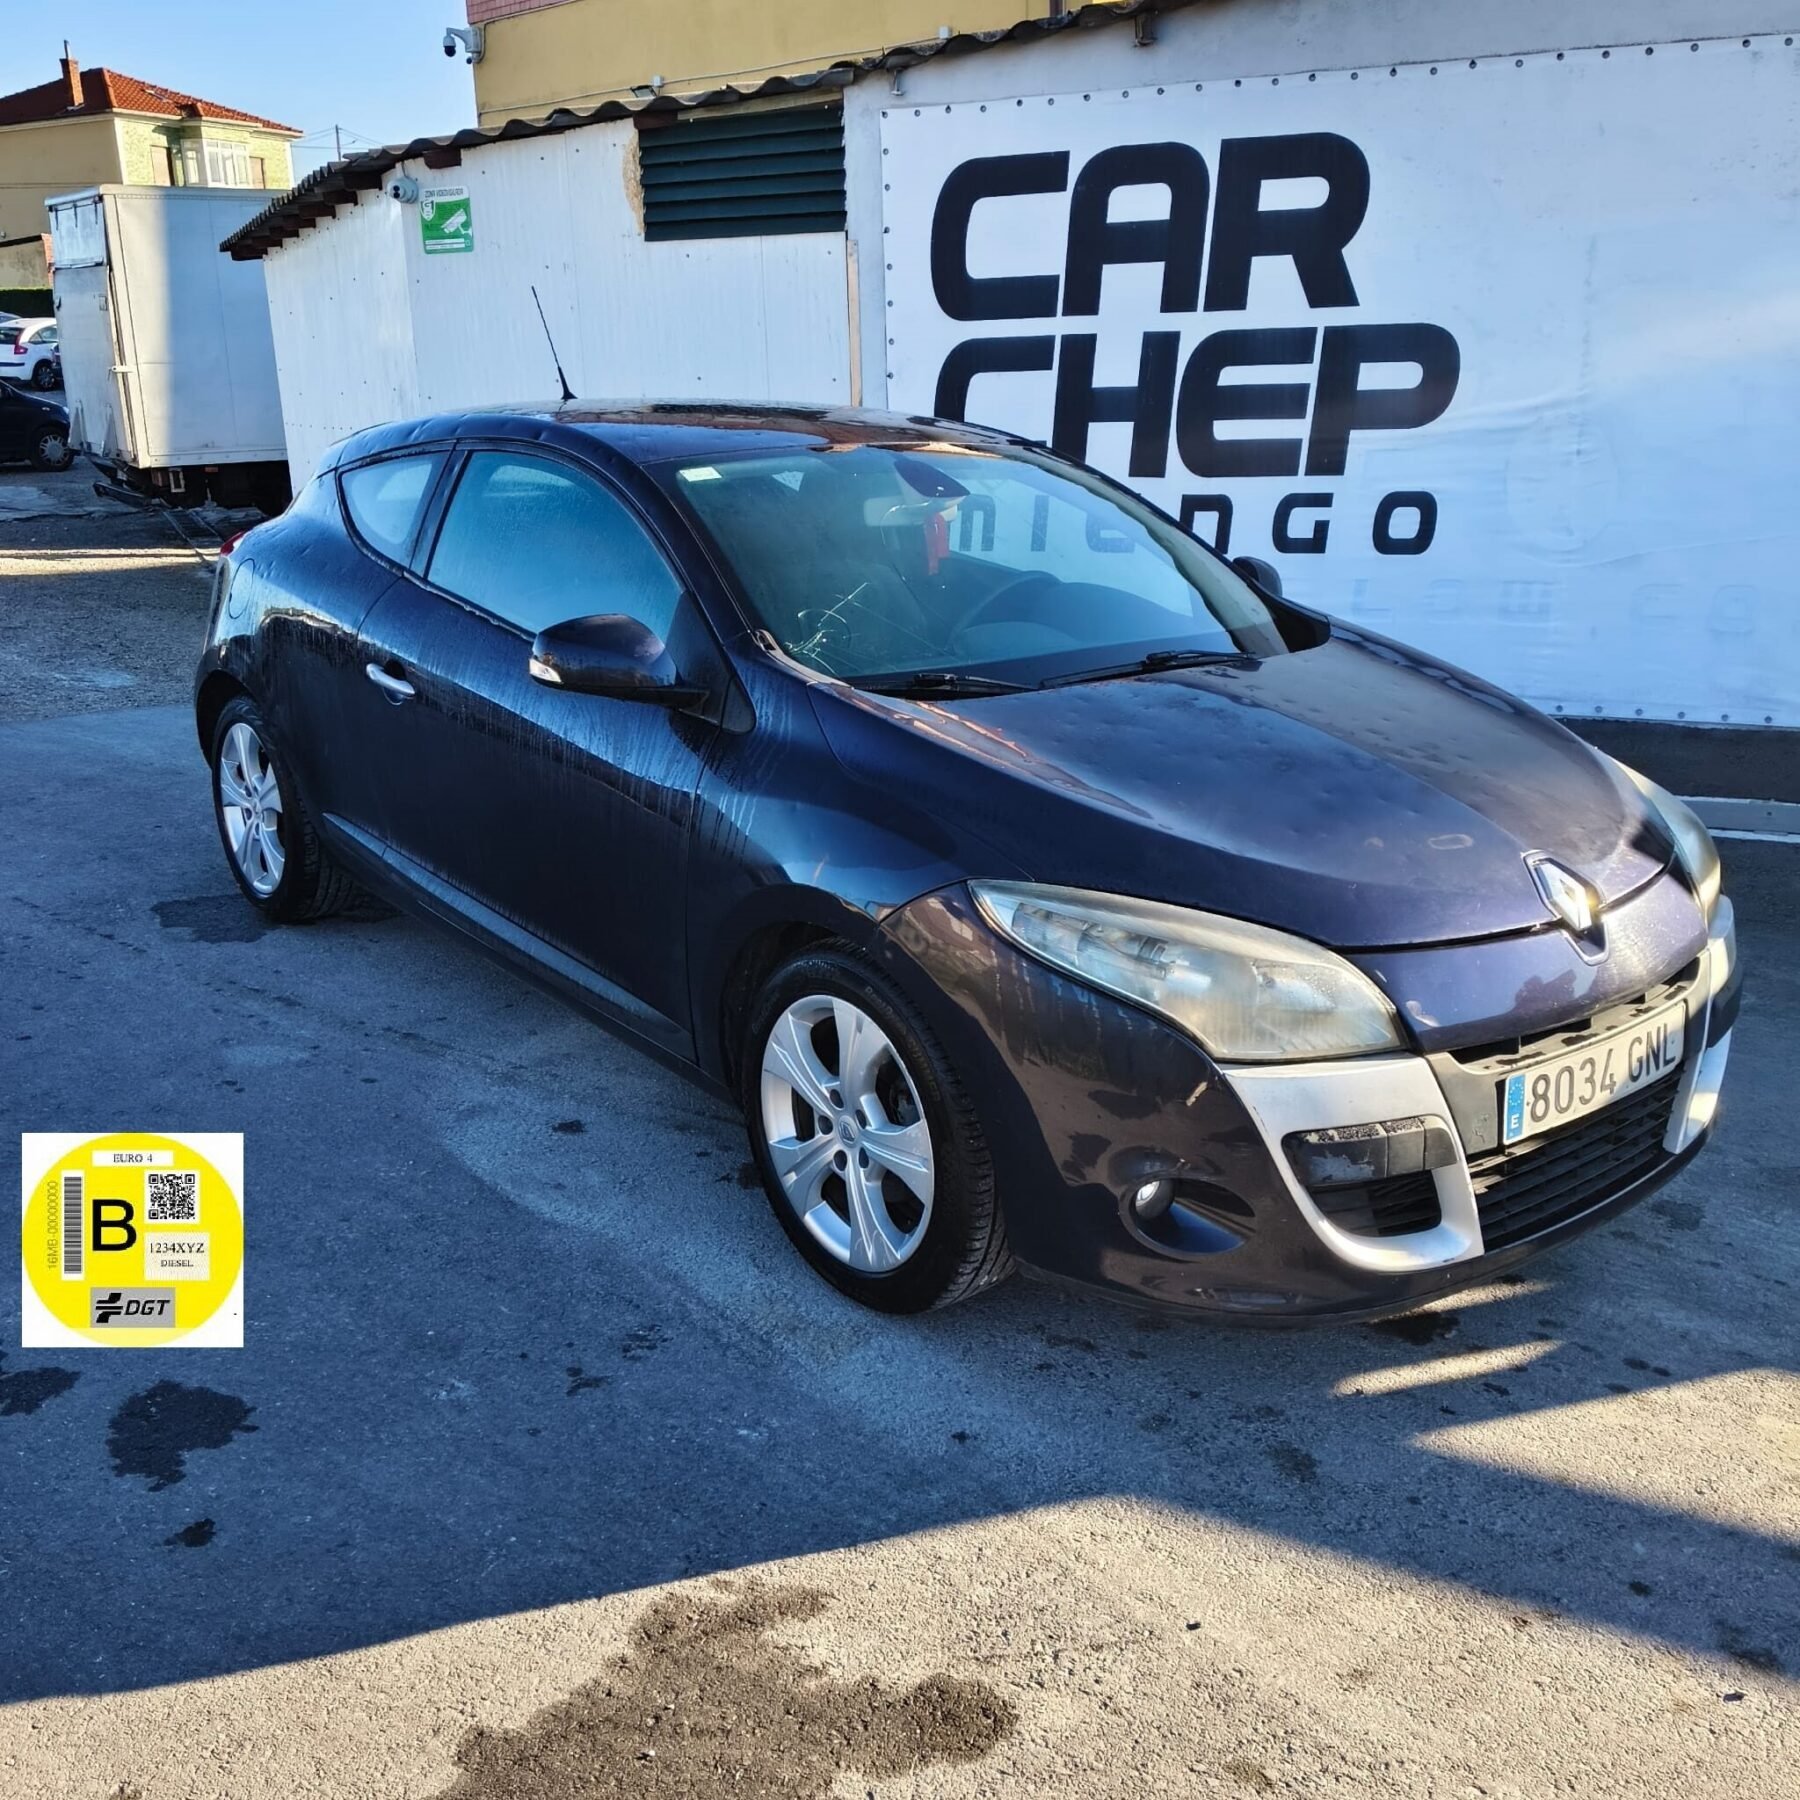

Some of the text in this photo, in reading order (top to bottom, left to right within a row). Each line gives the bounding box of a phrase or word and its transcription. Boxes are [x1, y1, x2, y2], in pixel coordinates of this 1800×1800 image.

[931, 132, 1370, 321] CAR
[934, 322, 1461, 478] CHEP
[1511, 1113, 1520, 1129] E
[1530, 1023, 1676, 1123] 8034 GNL
